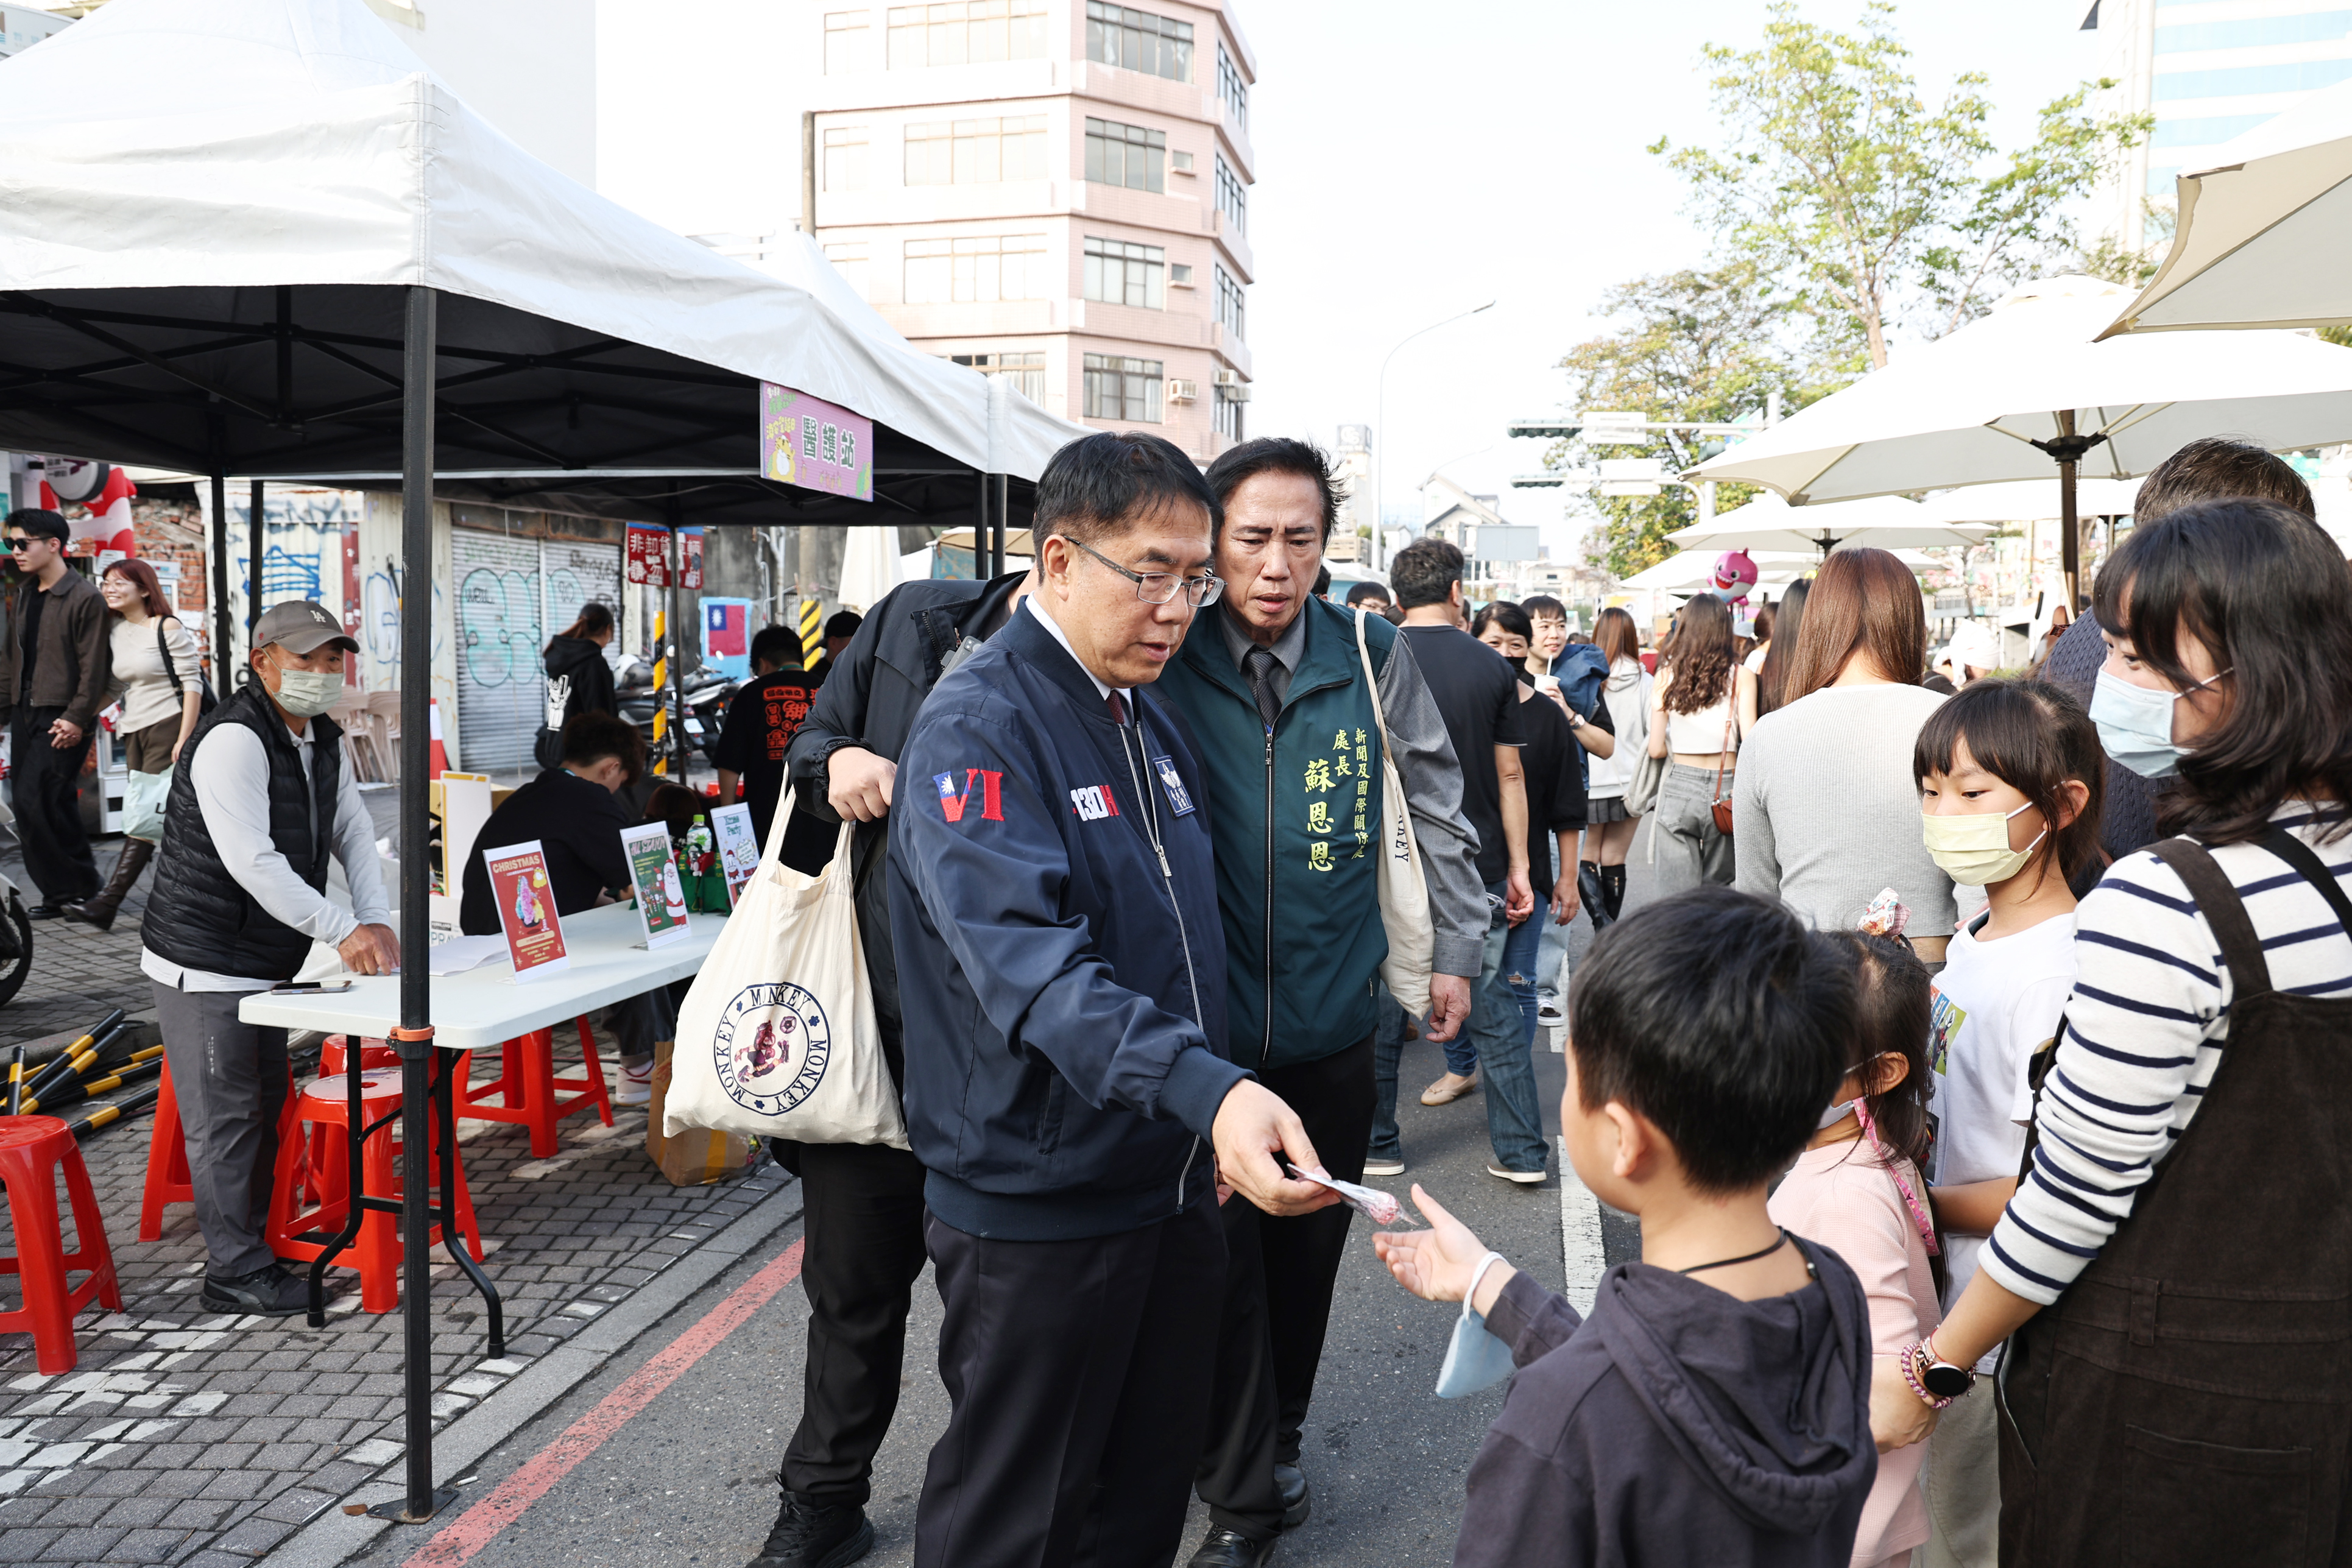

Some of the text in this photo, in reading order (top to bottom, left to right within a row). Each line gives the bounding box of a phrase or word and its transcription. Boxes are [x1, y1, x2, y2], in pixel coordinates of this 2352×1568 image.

[802, 414, 855, 470] 醫護站
[310, 610, 327, 623] LA
[1332, 729, 1352, 777] 處長
[1304, 758, 1337, 872] 蘇恩恩
[492, 855, 540, 874] CHRISTMAS
[749, 985, 811, 1012] MNKEY
[716, 1017, 746, 1102] MONKEY
[774, 1039, 827, 1111] MONKEY
